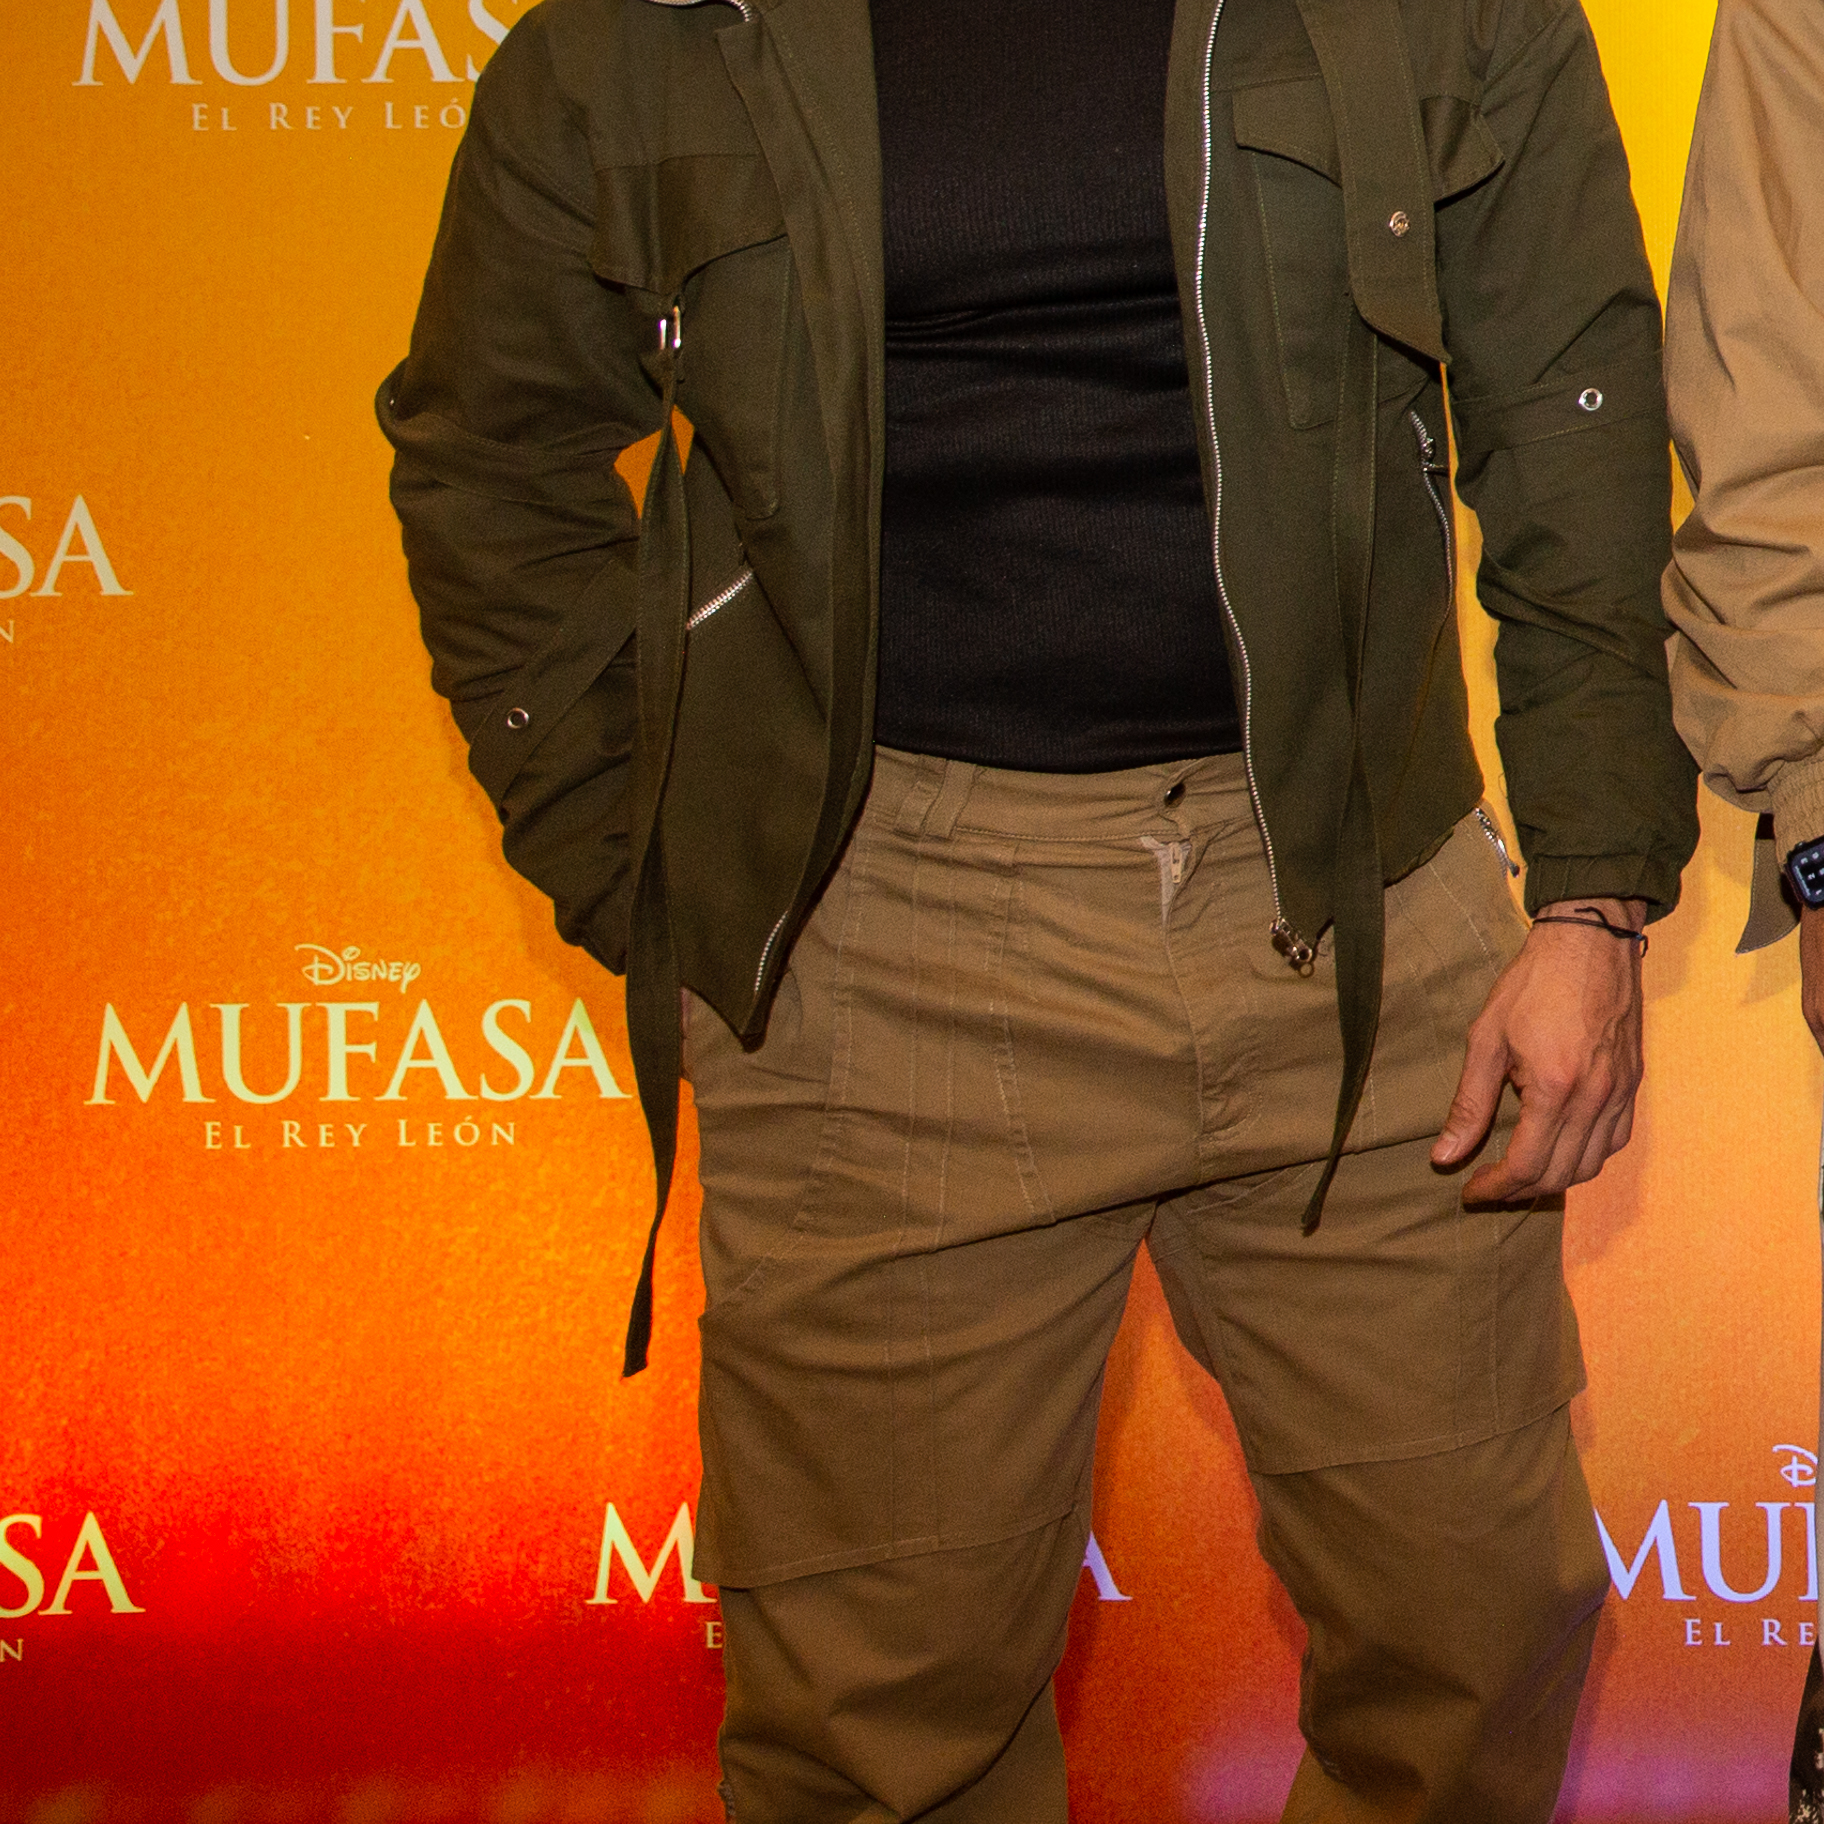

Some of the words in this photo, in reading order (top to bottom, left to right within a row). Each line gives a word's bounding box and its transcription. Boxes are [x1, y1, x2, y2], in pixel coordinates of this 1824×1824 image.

[385, 98, 465, 129] LEÓ
[86, 998, 630, 1105] MUFASA
[1762, 1619, 1814, 1646] RE
